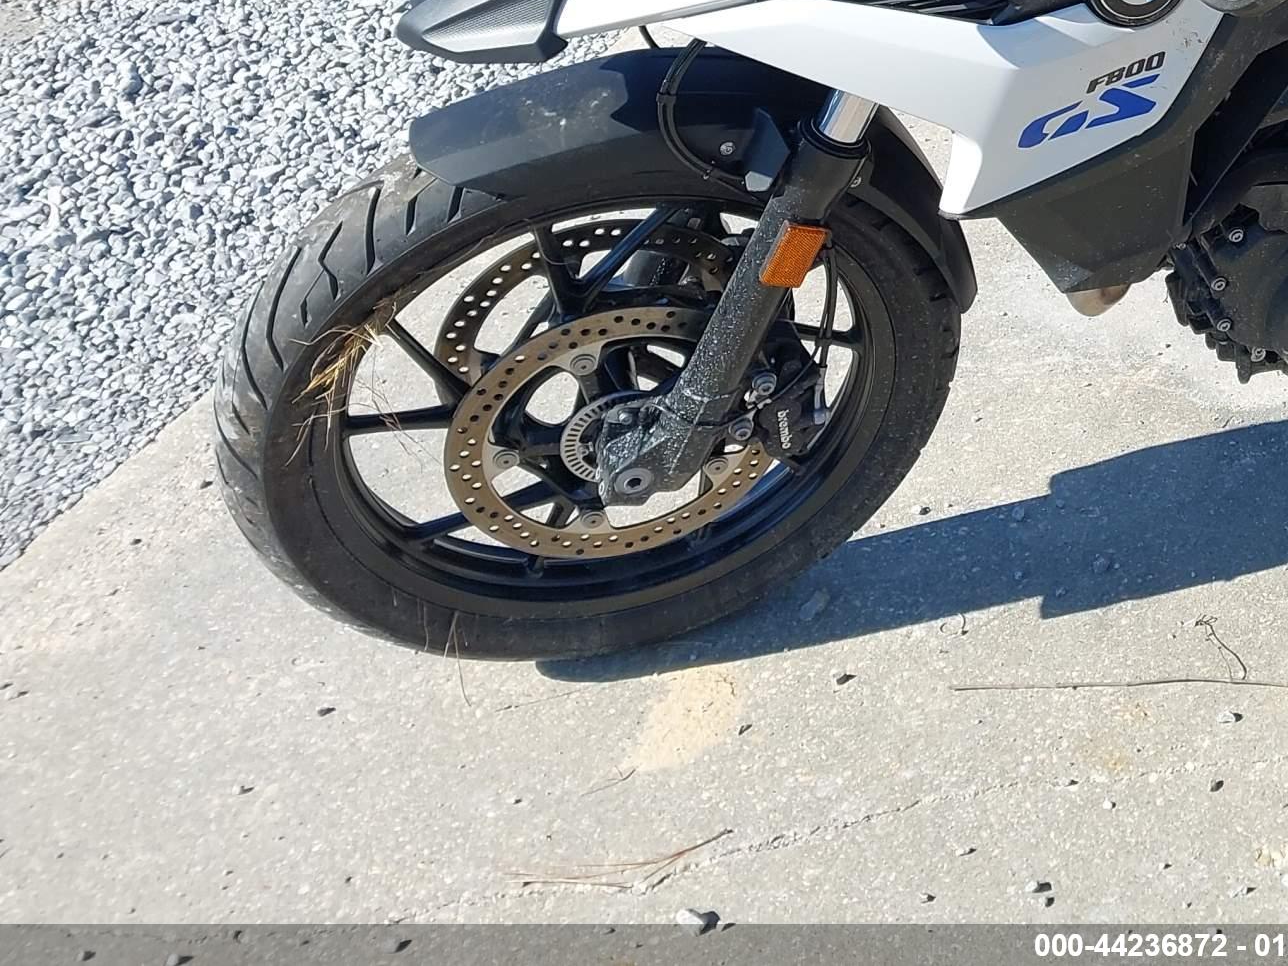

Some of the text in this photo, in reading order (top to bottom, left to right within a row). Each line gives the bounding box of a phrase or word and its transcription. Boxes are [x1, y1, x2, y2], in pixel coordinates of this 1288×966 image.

[1086, 51, 1166, 94] F800
[1017, 74, 1161, 149] GS
[777, 409, 793, 449] brembo
